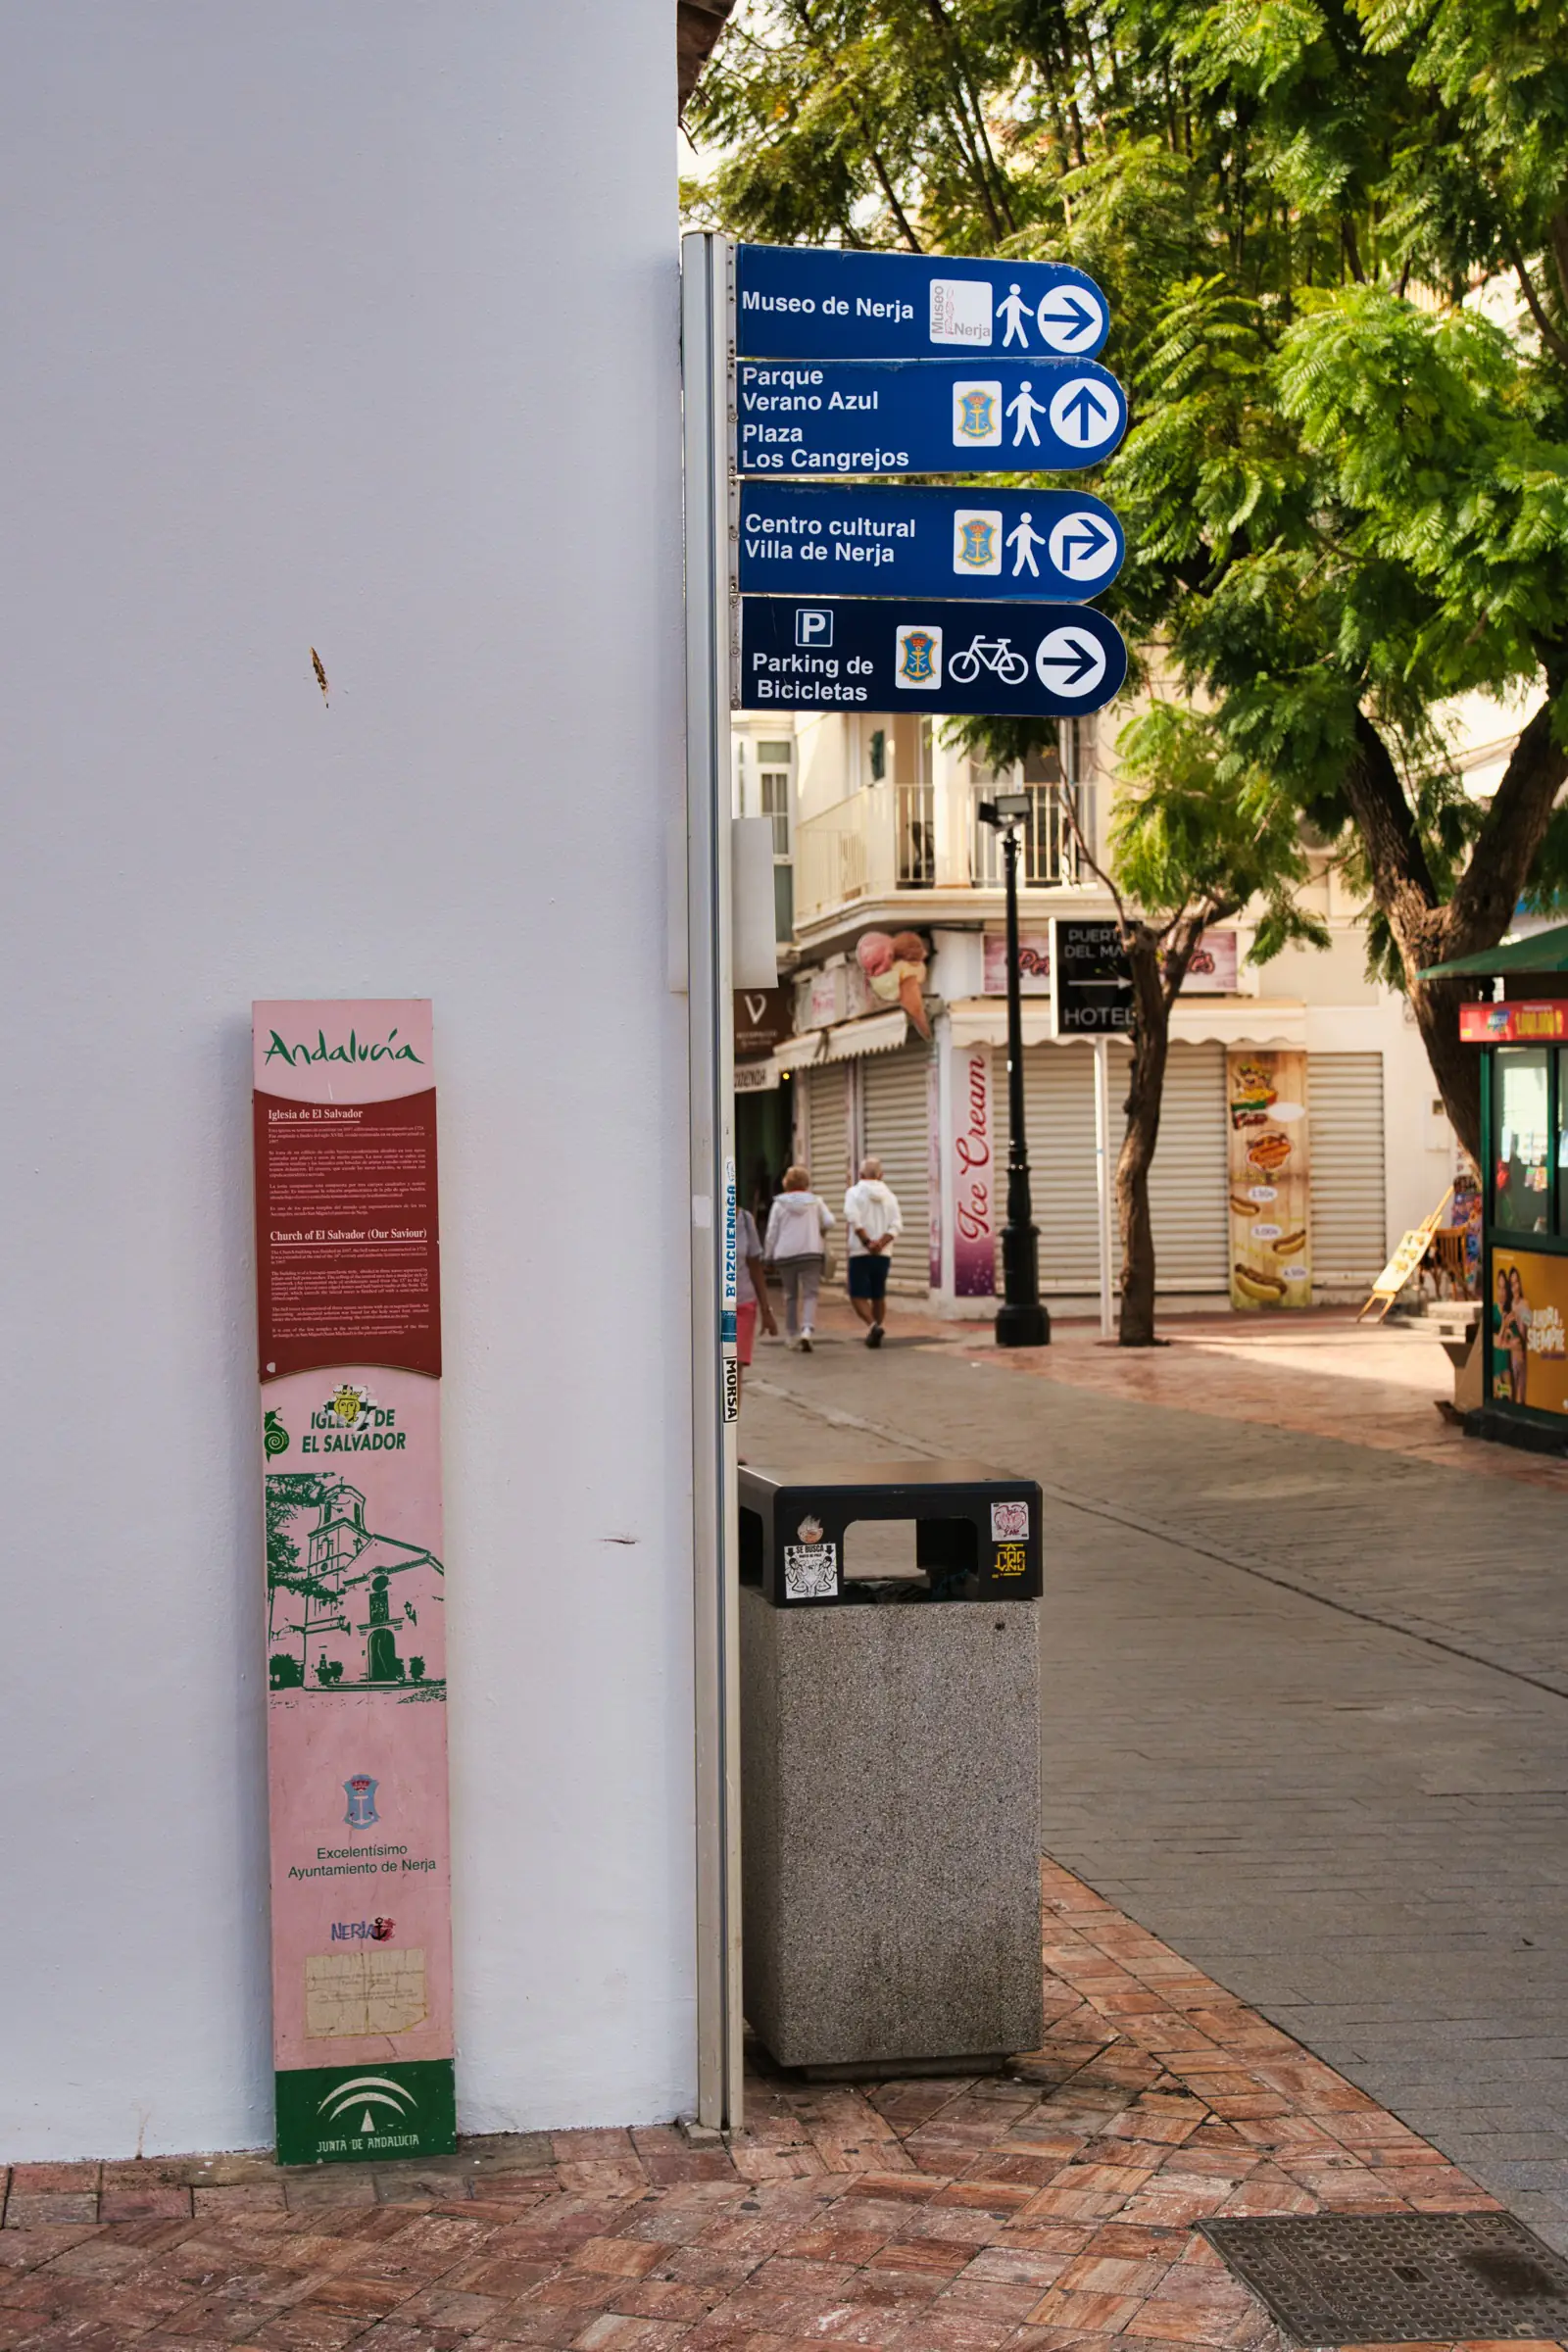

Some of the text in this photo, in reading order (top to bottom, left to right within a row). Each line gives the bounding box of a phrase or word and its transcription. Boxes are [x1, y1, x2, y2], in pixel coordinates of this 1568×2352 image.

[742, 292, 913, 322] Museo de Nerja
[932, 286, 944, 334] Museo
[955, 322, 991, 340] Nerja
[743, 368, 823, 388] Parque
[743, 391, 879, 412] Verano Azul
[743, 424, 803, 442] Plaza
[743, 449, 909, 470] Los Cangrejos
[745, 514, 916, 538] Centro cultural
[745, 540, 895, 566] Villa de Nerja
[803, 612, 826, 643] P
[753, 653, 874, 677] Parking de
[757, 680, 867, 702] Bicicletas
[1067, 929, 1125, 943] PUERT
[1064, 944, 1126, 958] DEL MA
[1064, 1006, 1136, 1025] HOTEL
[263, 1028, 425, 1066] Andalucía
[269, 1109, 363, 1121] Iglesia de El Salvador
[956, 1055, 991, 1241] Ice Cream
[270, 1228, 426, 1241] Church of El Salvador (Our Saviour)
[725, 1359, 737, 1419] MORSA
[374, 1409, 395, 1427] DE
[302, 1432, 406, 1453] EL SALVADOR
[797, 1544, 824, 1554] SE BUSCA
[317, 1844, 408, 1859] Excelentísimo
[288, 1858, 436, 1881] Ayuntamiento de Nerja
[316, 2138, 347, 2153] JUNTA
[352, 2137, 364, 2149] DE
